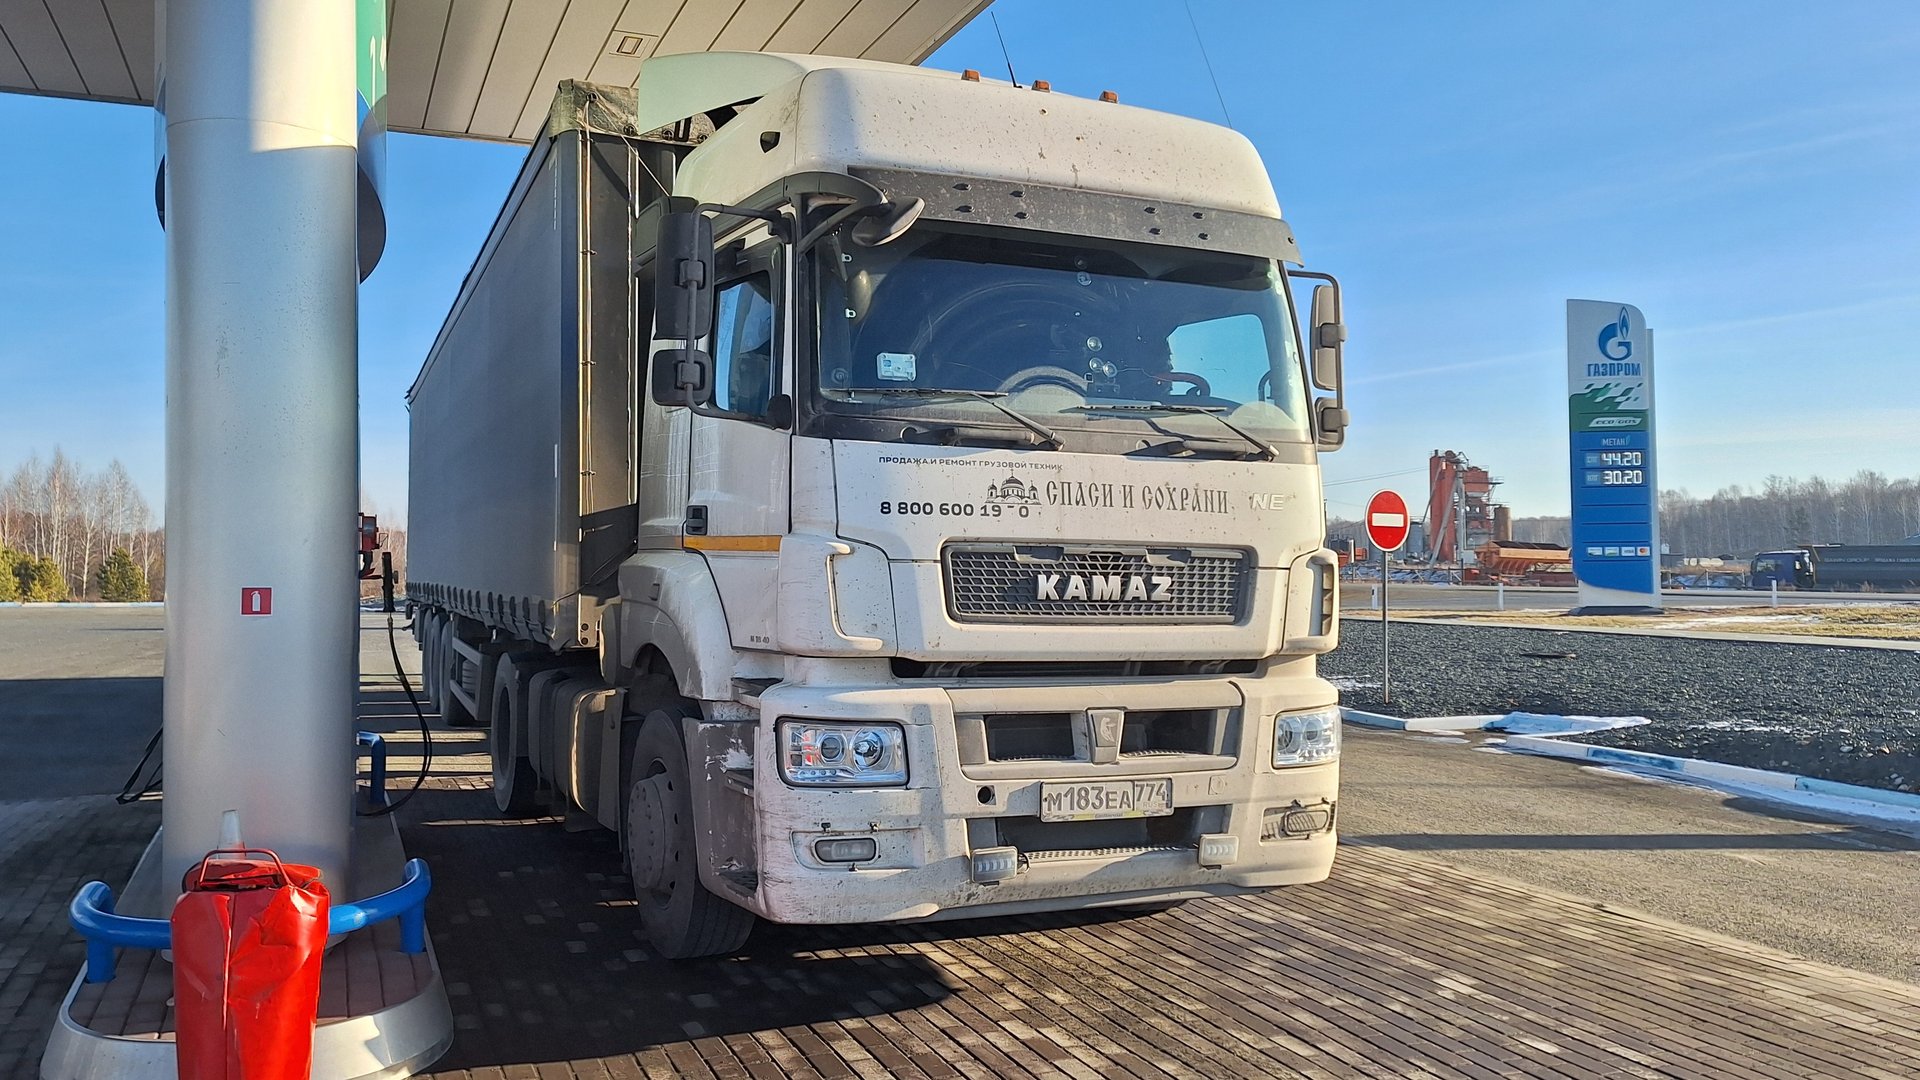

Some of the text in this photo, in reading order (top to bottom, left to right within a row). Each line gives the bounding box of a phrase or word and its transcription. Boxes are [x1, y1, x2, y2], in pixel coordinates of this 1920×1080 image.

[1587, 362, 1642, 377] ГАЗПРОМ
[1602, 438, 1626, 447] МЕТАН
[878, 456, 931, 466] ПРОДАЖА
[939, 459, 977, 467] РЕМОНТ
[978, 460, 1027, 469] ГРУЗОВОЙ
[1601, 451, 1642, 466] 44.20
[1602, 470, 1643, 485] 30.20
[1046, 480, 1229, 514] СПАСИ И СОХРАНИ
[1251, 492, 1285, 511] NE
[880, 501, 892, 515] 8
[897, 501, 934, 516] 800
[938, 503, 975, 517] 600
[1036, 573, 1173, 602] KAMAZ
